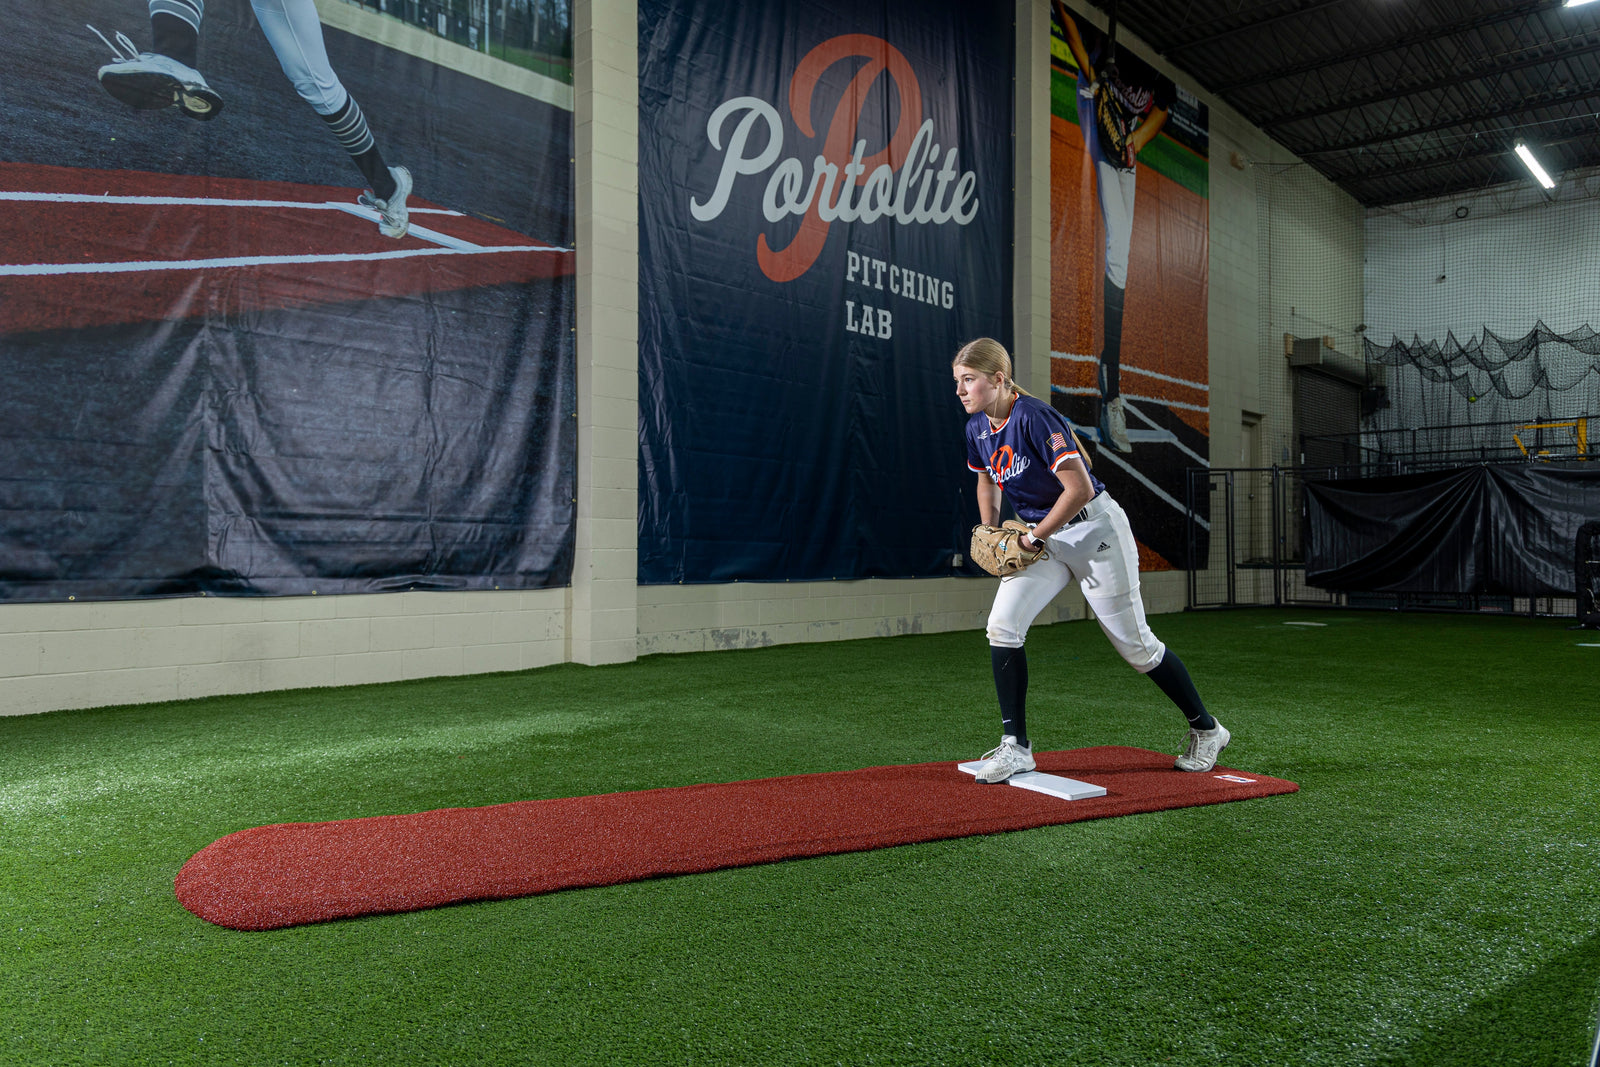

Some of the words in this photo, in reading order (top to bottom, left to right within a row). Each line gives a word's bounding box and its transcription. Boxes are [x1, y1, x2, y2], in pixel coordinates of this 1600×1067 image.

[690, 96, 979, 225] Portolite
[846, 250, 954, 309] PITCHING
[846, 300, 893, 339] LAB
